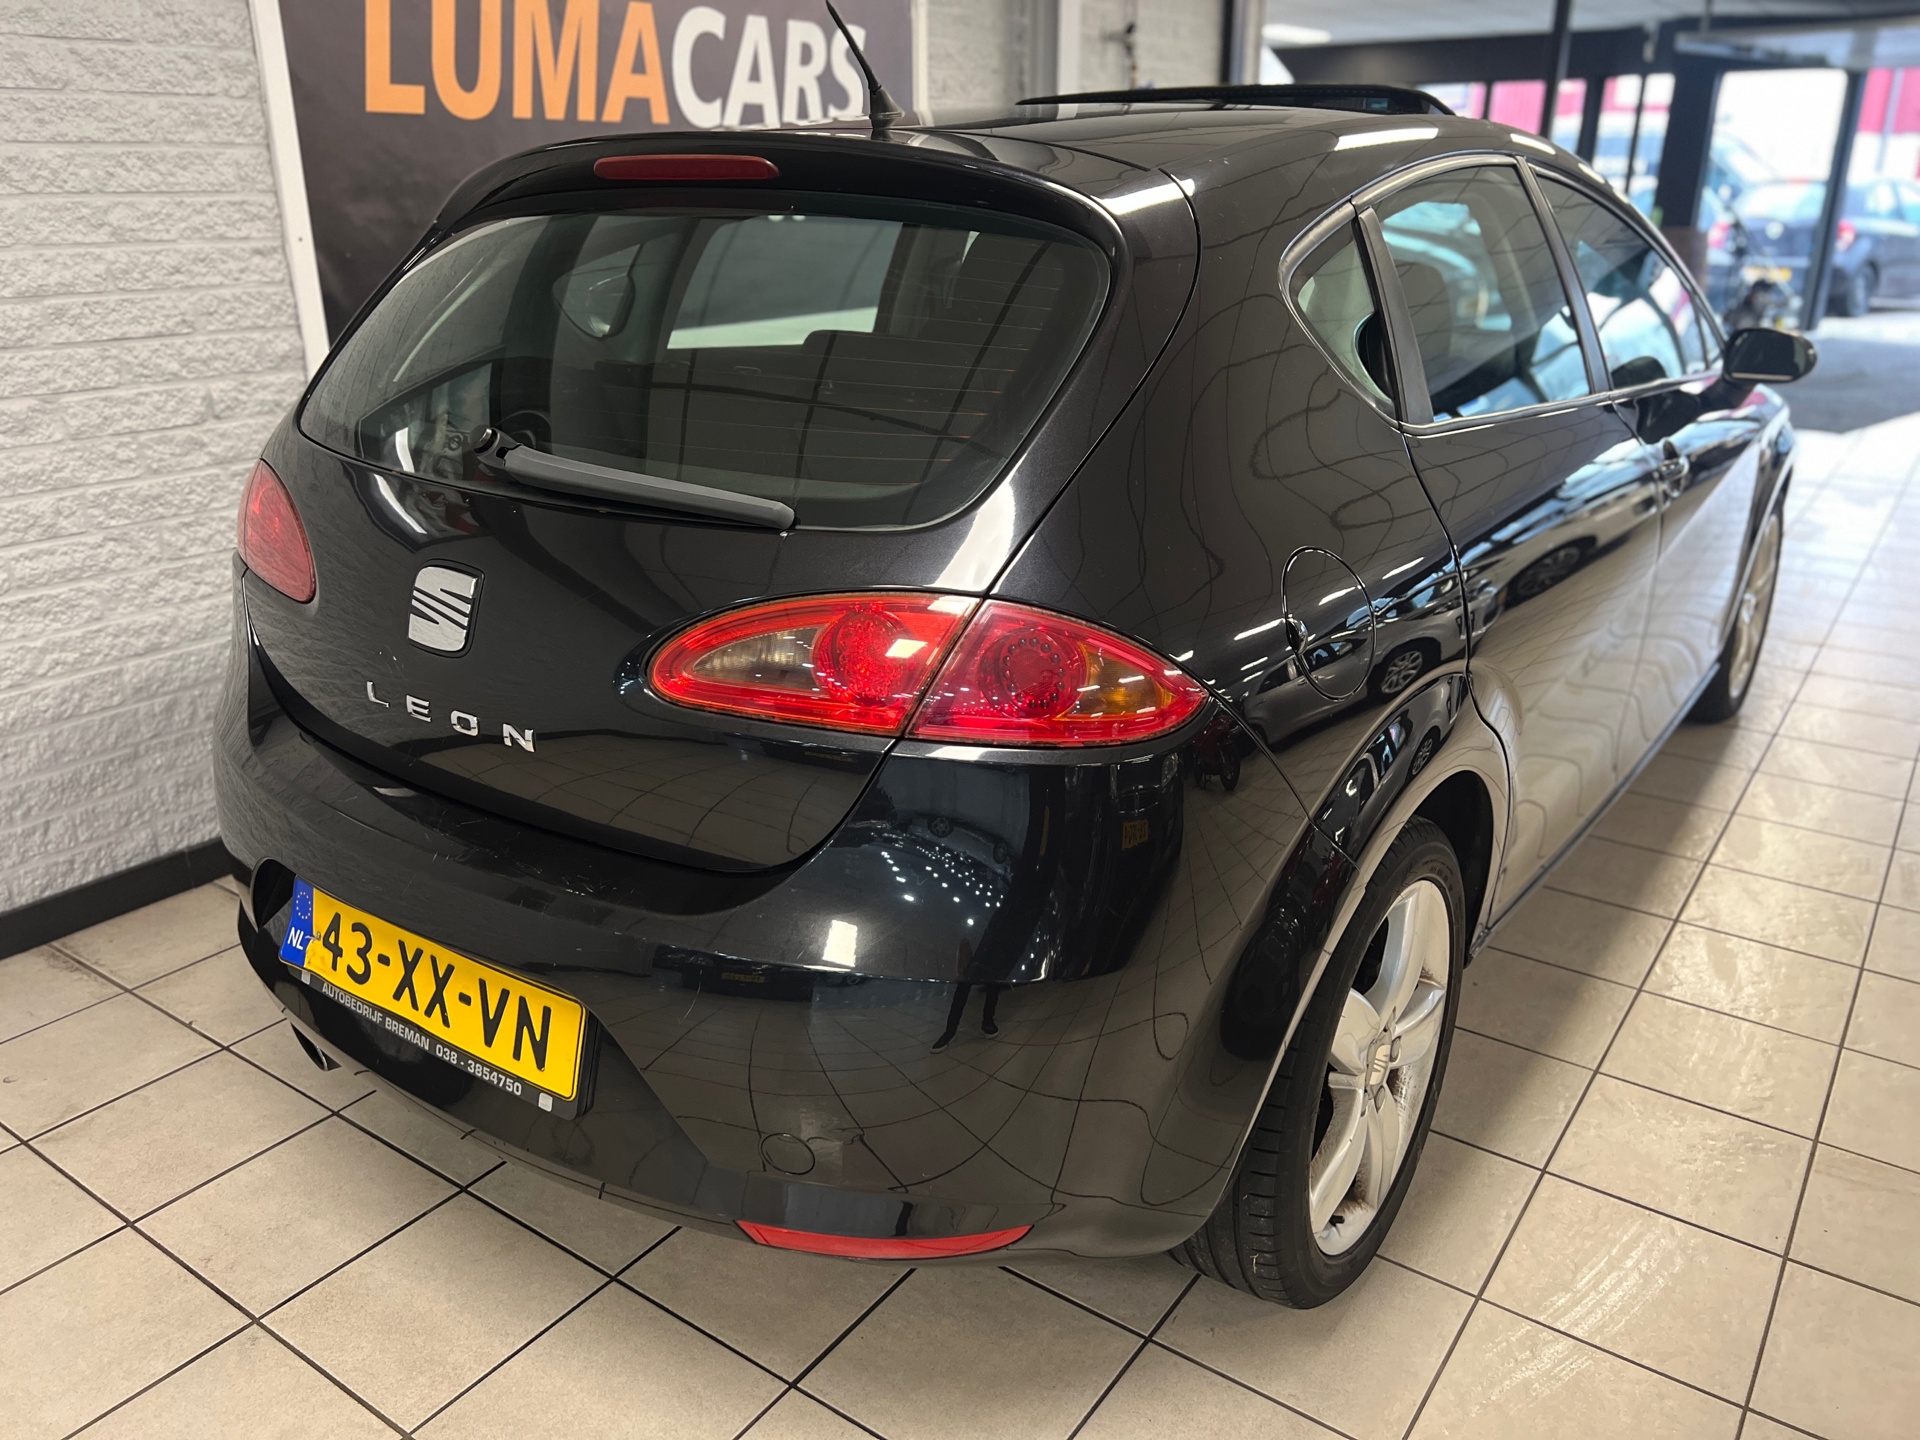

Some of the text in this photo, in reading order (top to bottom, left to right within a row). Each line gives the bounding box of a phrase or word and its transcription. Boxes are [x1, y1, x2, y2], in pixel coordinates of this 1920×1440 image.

[366, 680, 536, 753] LEON
[287, 926, 305, 951] NL
[322, 912, 552, 1072] 43-XX-VN
[321, 982, 384, 1025] AUTOBEDRIJF
[385, 1016, 430, 1051] BREMAN
[435, 1044, 458, 1066] 038
[467, 1060, 523, 1097] 3854750
